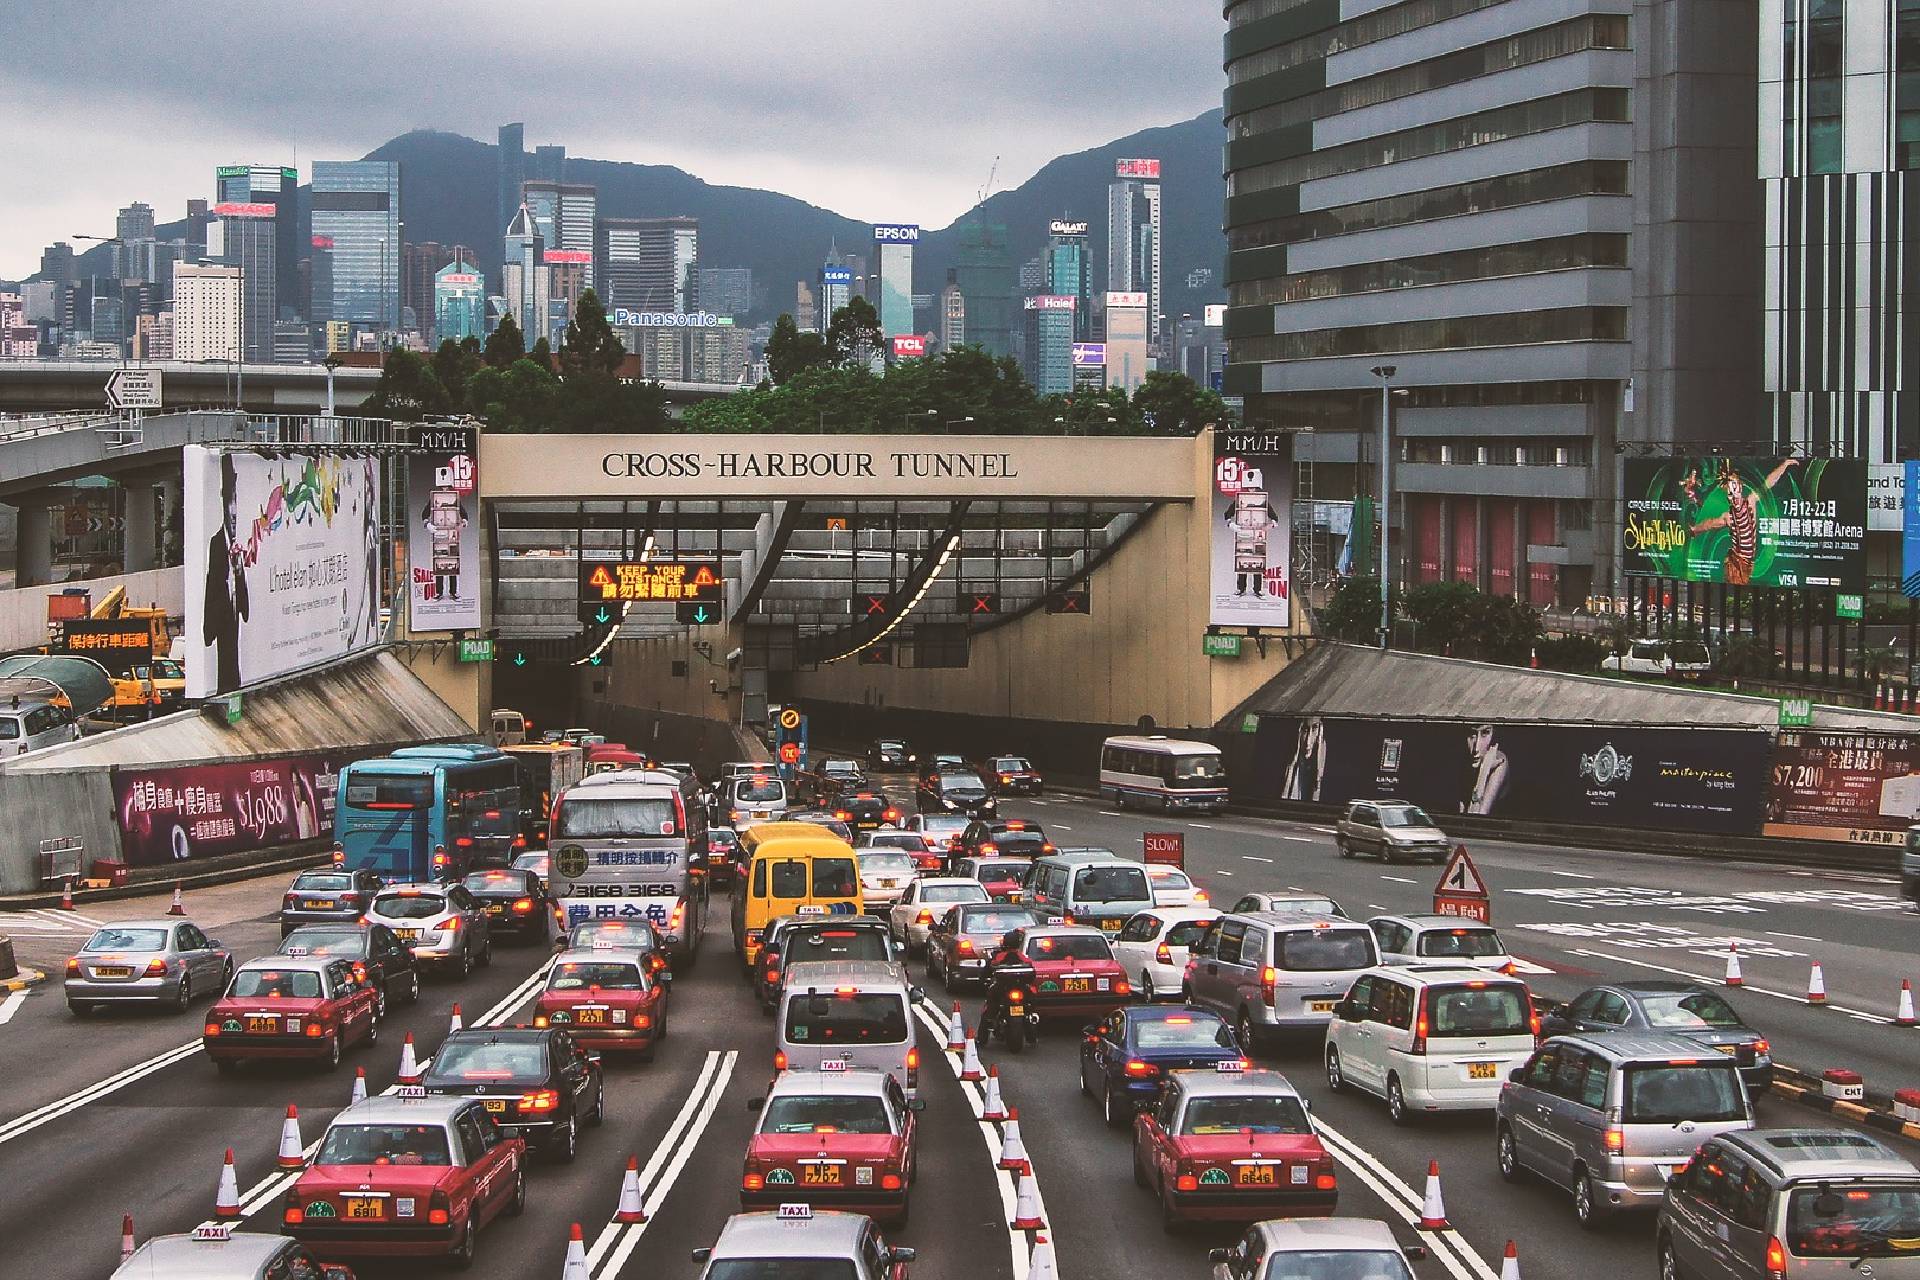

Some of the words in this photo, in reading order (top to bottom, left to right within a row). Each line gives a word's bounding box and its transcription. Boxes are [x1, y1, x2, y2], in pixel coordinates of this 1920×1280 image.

[875, 227, 918, 240] EPSON
[1044, 298, 1073, 308] Haier
[615, 308, 717, 326] Panasonic
[894, 339, 923, 350] TCL
[889, 453, 1018, 477] TUNNEL
[617, 566, 648, 575] KEEP
[655, 566, 685, 575] YOUR
[621, 575, 681, 584] DISTANCE
[1779, 575, 1798, 586] VISA
[1269, 580, 1287, 599] ON
[68, 632, 149, 649] 保持行車距離
[464, 641, 489, 654] POAD
[1146, 838, 1179, 851] SLOW!
[576, 883, 623, 897] 3168
[627, 883, 677, 897] 3168
[1220, 1062, 1241, 1070] TAXI
[402, 1087, 423, 1096] TAXI
[782, 1206, 808, 1216] TAXI
[198, 1228, 225, 1238] TAXI
